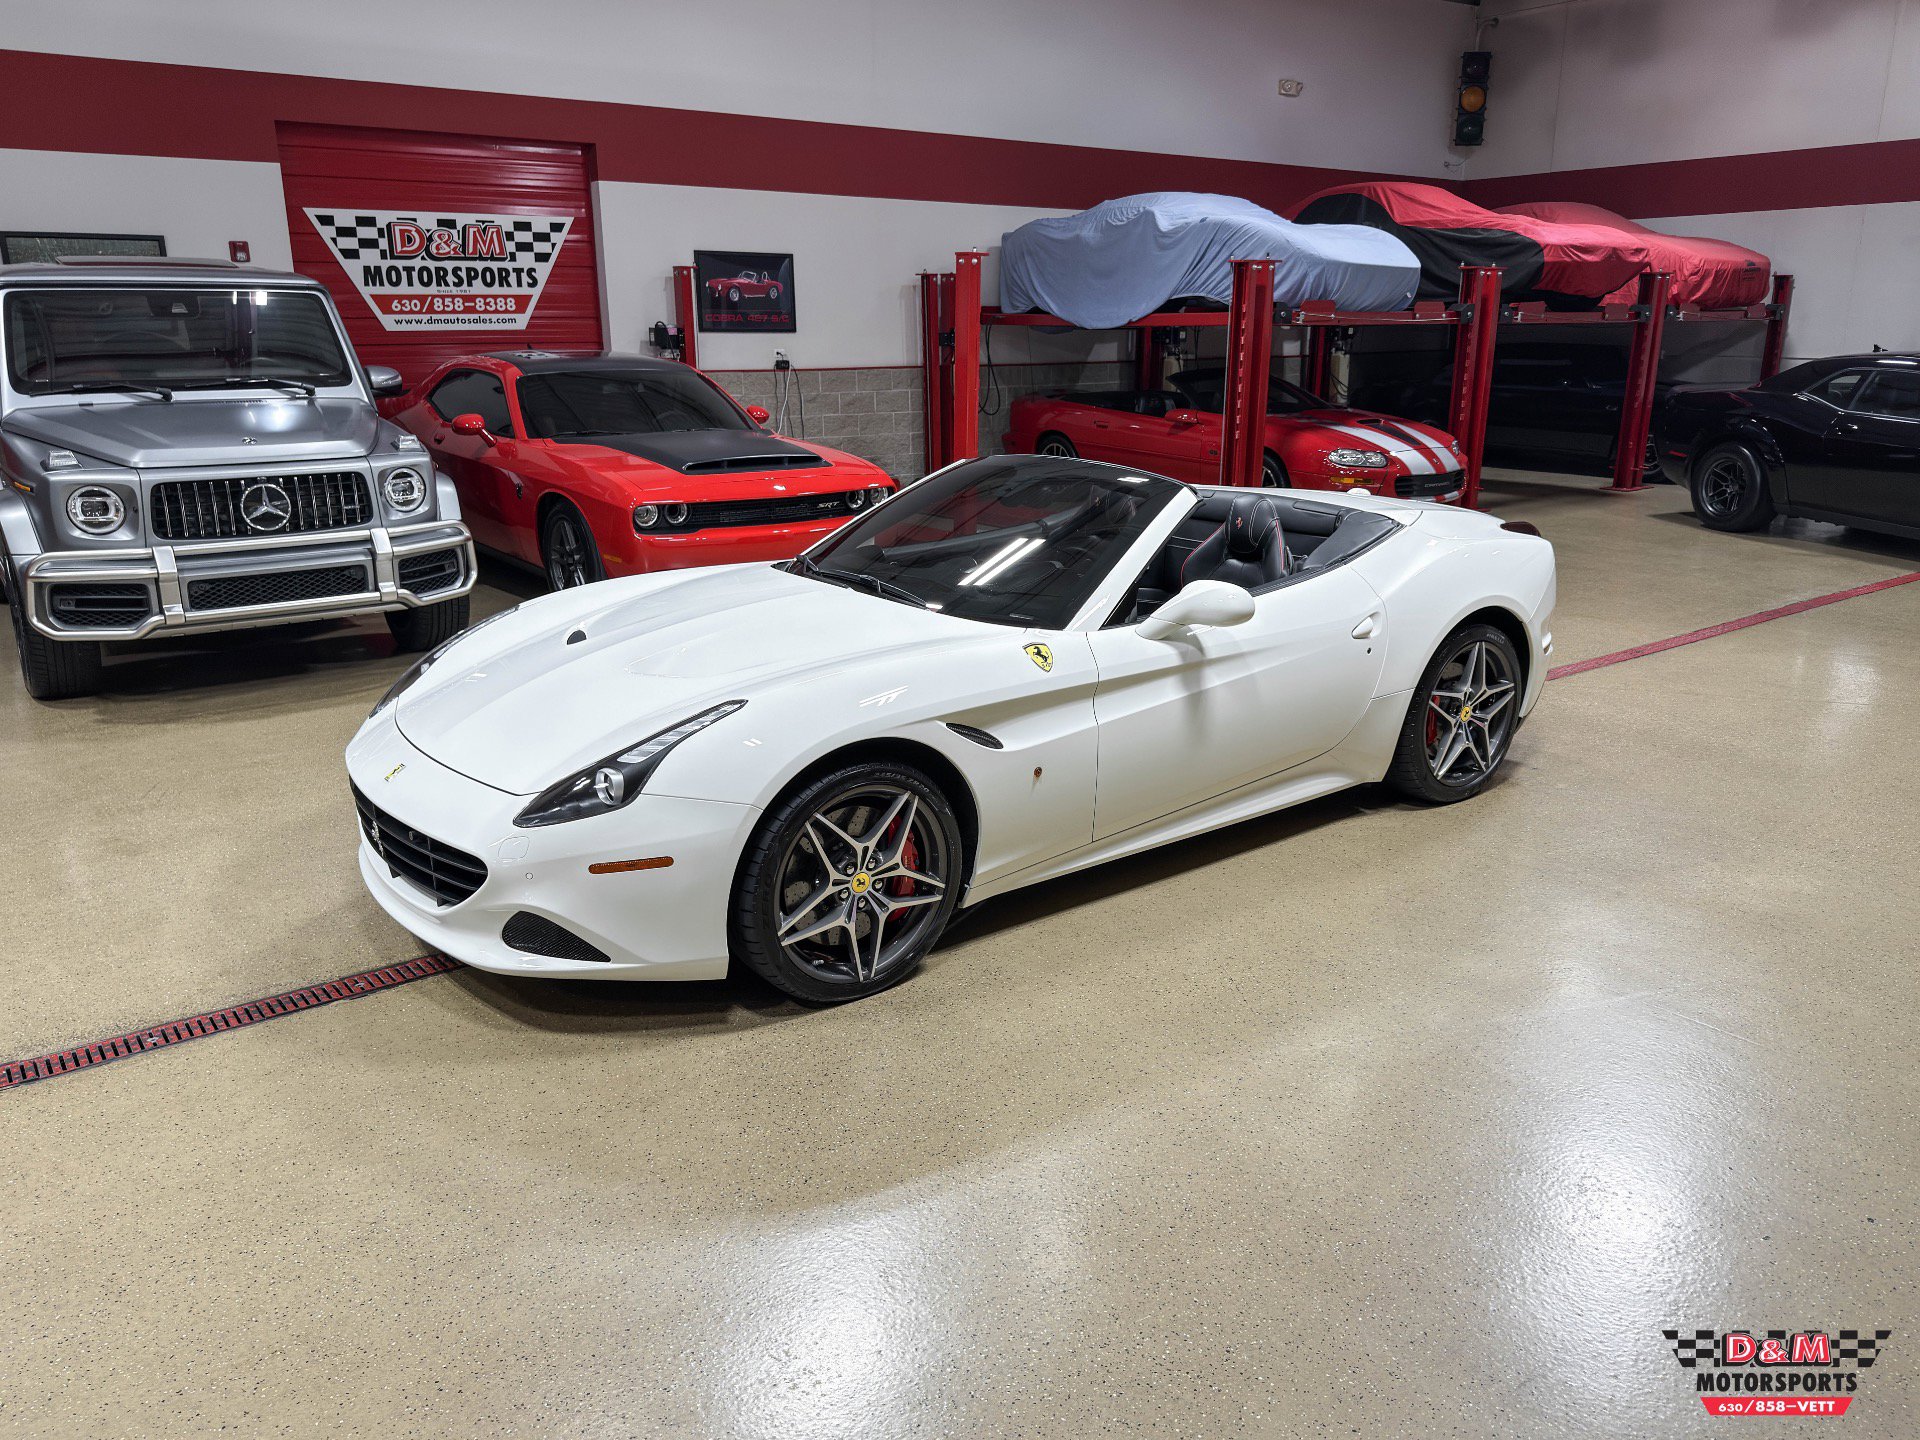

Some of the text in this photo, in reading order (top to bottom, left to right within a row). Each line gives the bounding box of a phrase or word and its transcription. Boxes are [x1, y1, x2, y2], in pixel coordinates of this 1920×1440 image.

[387, 221, 510, 260] D&M
[363, 265, 538, 288] MOTORSPORTS
[391, 296, 516, 313] 630/858-8388
[394, 315, 517, 326] www.dmautosales.com
[705, 313, 743, 322] COBRA
[816, 501, 840, 509] SRT
